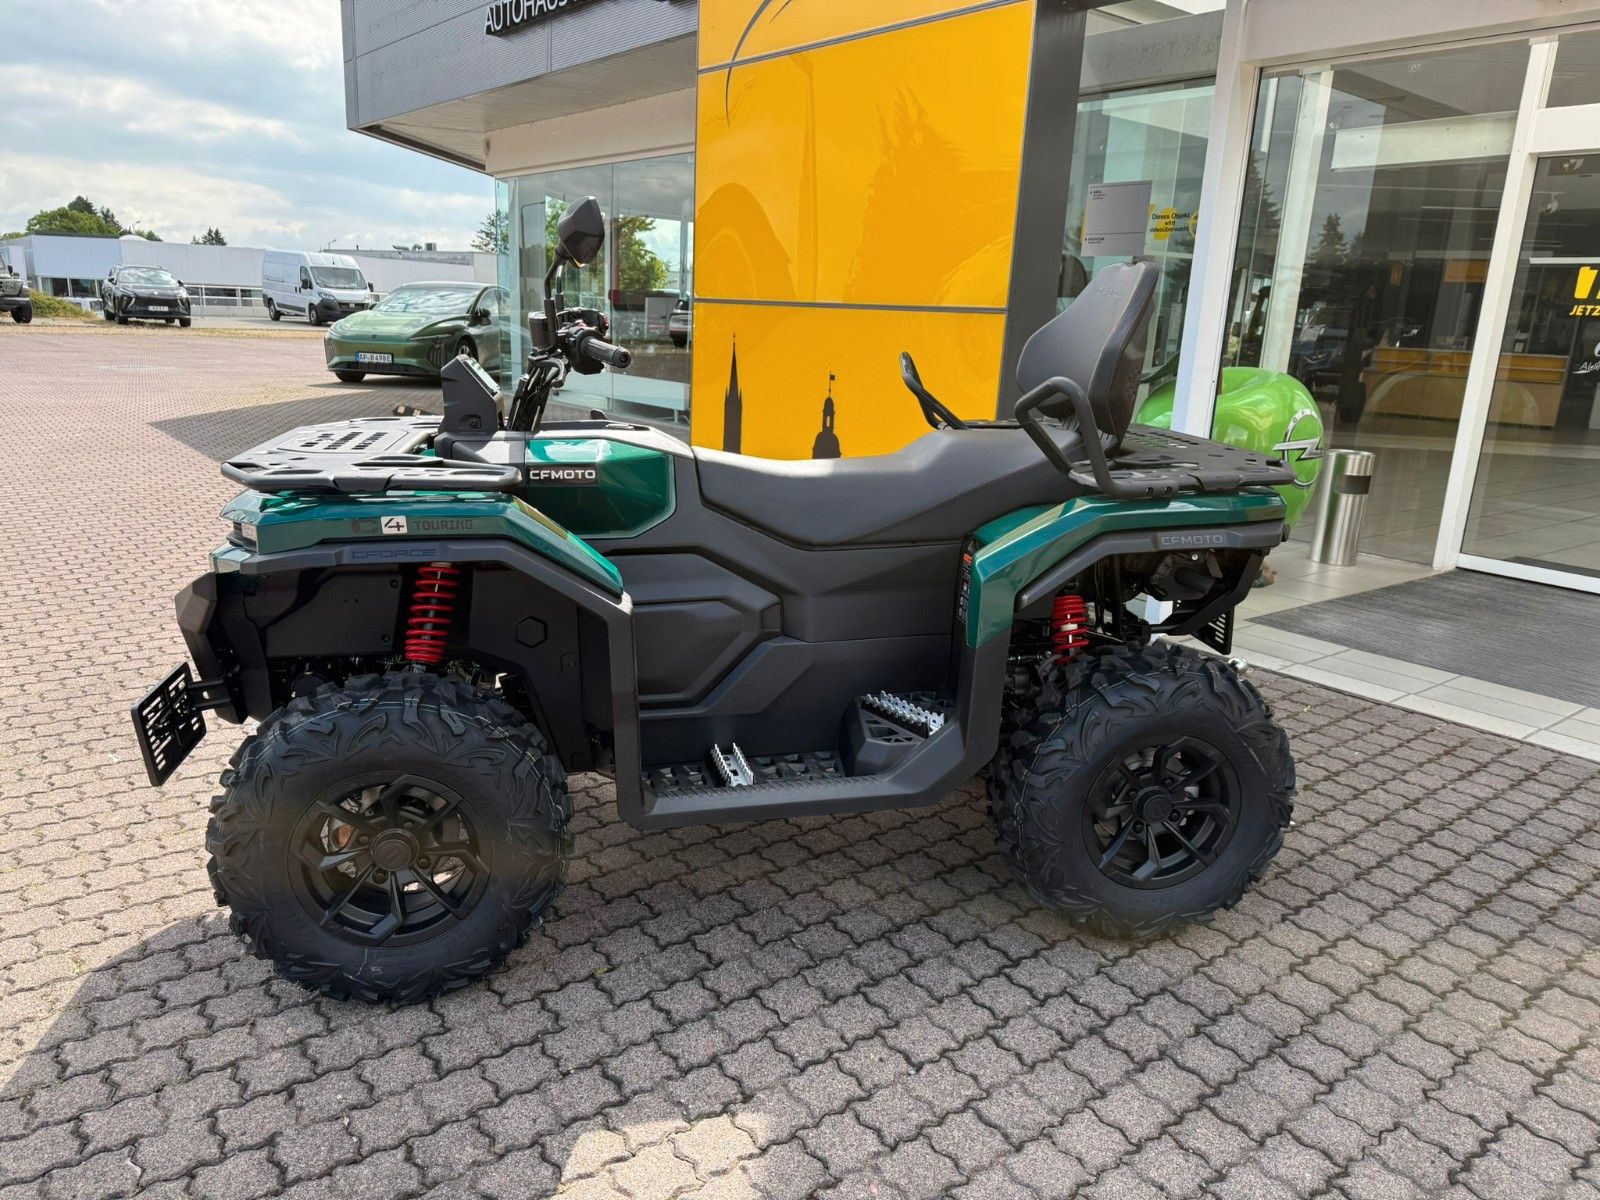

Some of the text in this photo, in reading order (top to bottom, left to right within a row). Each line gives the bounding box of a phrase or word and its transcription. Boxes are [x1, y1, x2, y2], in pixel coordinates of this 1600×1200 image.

[1171, 212, 1190, 220] Objekt
[529, 468, 596, 481] CFMOTO
[414, 519, 473, 531] TOURING
[1161, 534, 1223, 545] CFMOTO
[352, 548, 437, 559] CFORCE
